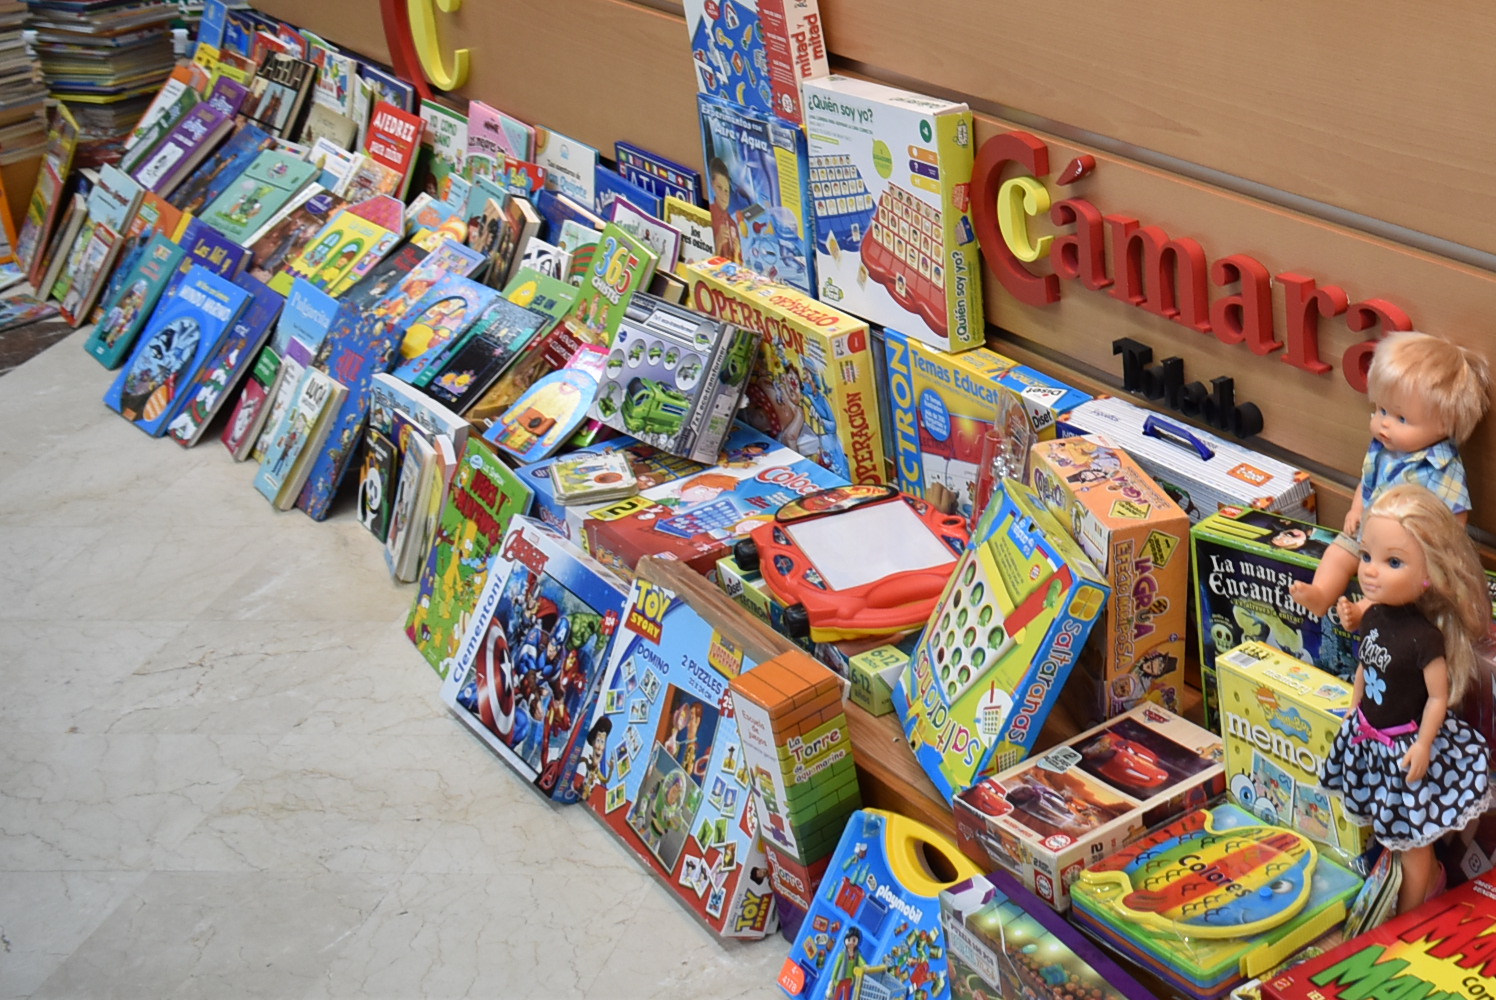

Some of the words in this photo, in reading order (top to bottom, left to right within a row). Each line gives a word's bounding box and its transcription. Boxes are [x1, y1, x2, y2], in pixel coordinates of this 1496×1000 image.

[803, 13, 824, 60] mitad
[791, 30, 812, 78] mitad
[808, 93, 839, 113] ¿Quién
[840, 104, 856, 119] soy
[856, 108, 873, 123] yo?
[373, 111, 415, 142] AJEDREZ
[714, 120, 736, 140] Aire
[740, 133, 768, 152] Agua
[594, 236, 640, 294] 365
[952, 251, 966, 273] yo?
[971, 130, 1413, 393] Cámara
[591, 276, 621, 305] CHISTES
[956, 275, 967, 297] soy
[694, 280, 805, 354] OPERACIÓN
[955, 299, 970, 342] ¿Quién
[700, 346, 726, 411] eco-transformer
[911, 349, 951, 383] Temas
[1032, 409, 1052, 427] Diset
[726, 577, 741, 596] Diset
[1209, 555, 1235, 574] La
[1240, 560, 1298, 588] mansi
[635, 579, 671, 623] TOY
[630, 613, 661, 637] STORY
[637, 643, 670, 675] DOMINO
[870, 648, 900, 667] 6-12
[681, 654, 688, 666] 2
[688, 659, 723, 695] PUZZLES
[851, 667, 872, 693] 6-12
[1007, 619, 1082, 742] Saltaranas
[914, 649, 980, 765] Saltaranas
[787, 736, 802, 750] La
[790, 728, 841, 763] Torre
[794, 763, 804, 775] de
[1178, 854, 1253, 900] Colores
[736, 888, 758, 932] TOY
[875, 884, 924, 924] playmobil
[782, 976, 797, 993] 4178
